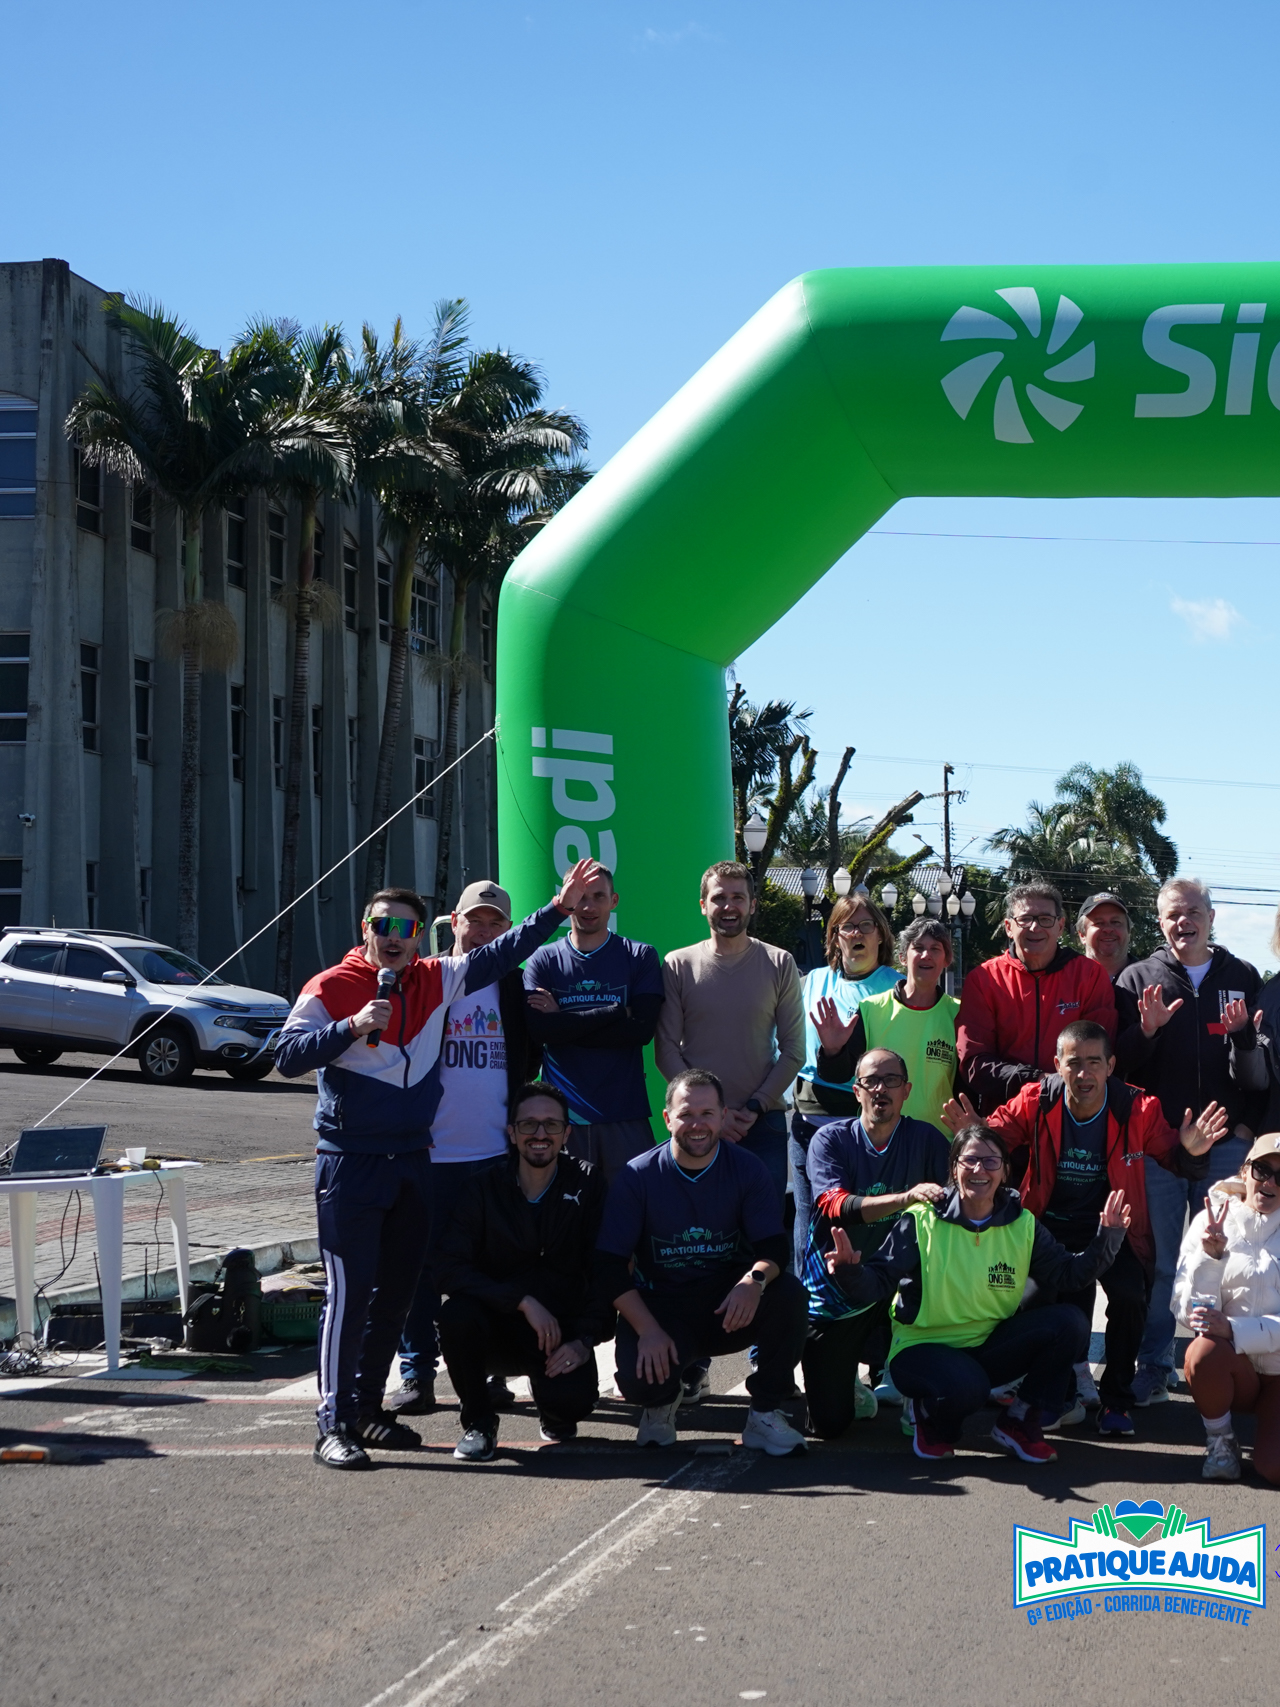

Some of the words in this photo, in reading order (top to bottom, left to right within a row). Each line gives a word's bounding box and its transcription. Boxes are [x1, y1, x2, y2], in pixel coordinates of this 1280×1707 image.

[558, 994, 595, 1005] PRATIQUE
[596, 994, 622, 1003] AJUDA
[490, 1042, 506, 1050] ENTR
[445, 1040, 488, 1069] ONG
[660, 1244, 706, 1256] PRATIQUE
[988, 1274, 1003, 1284] ONG
